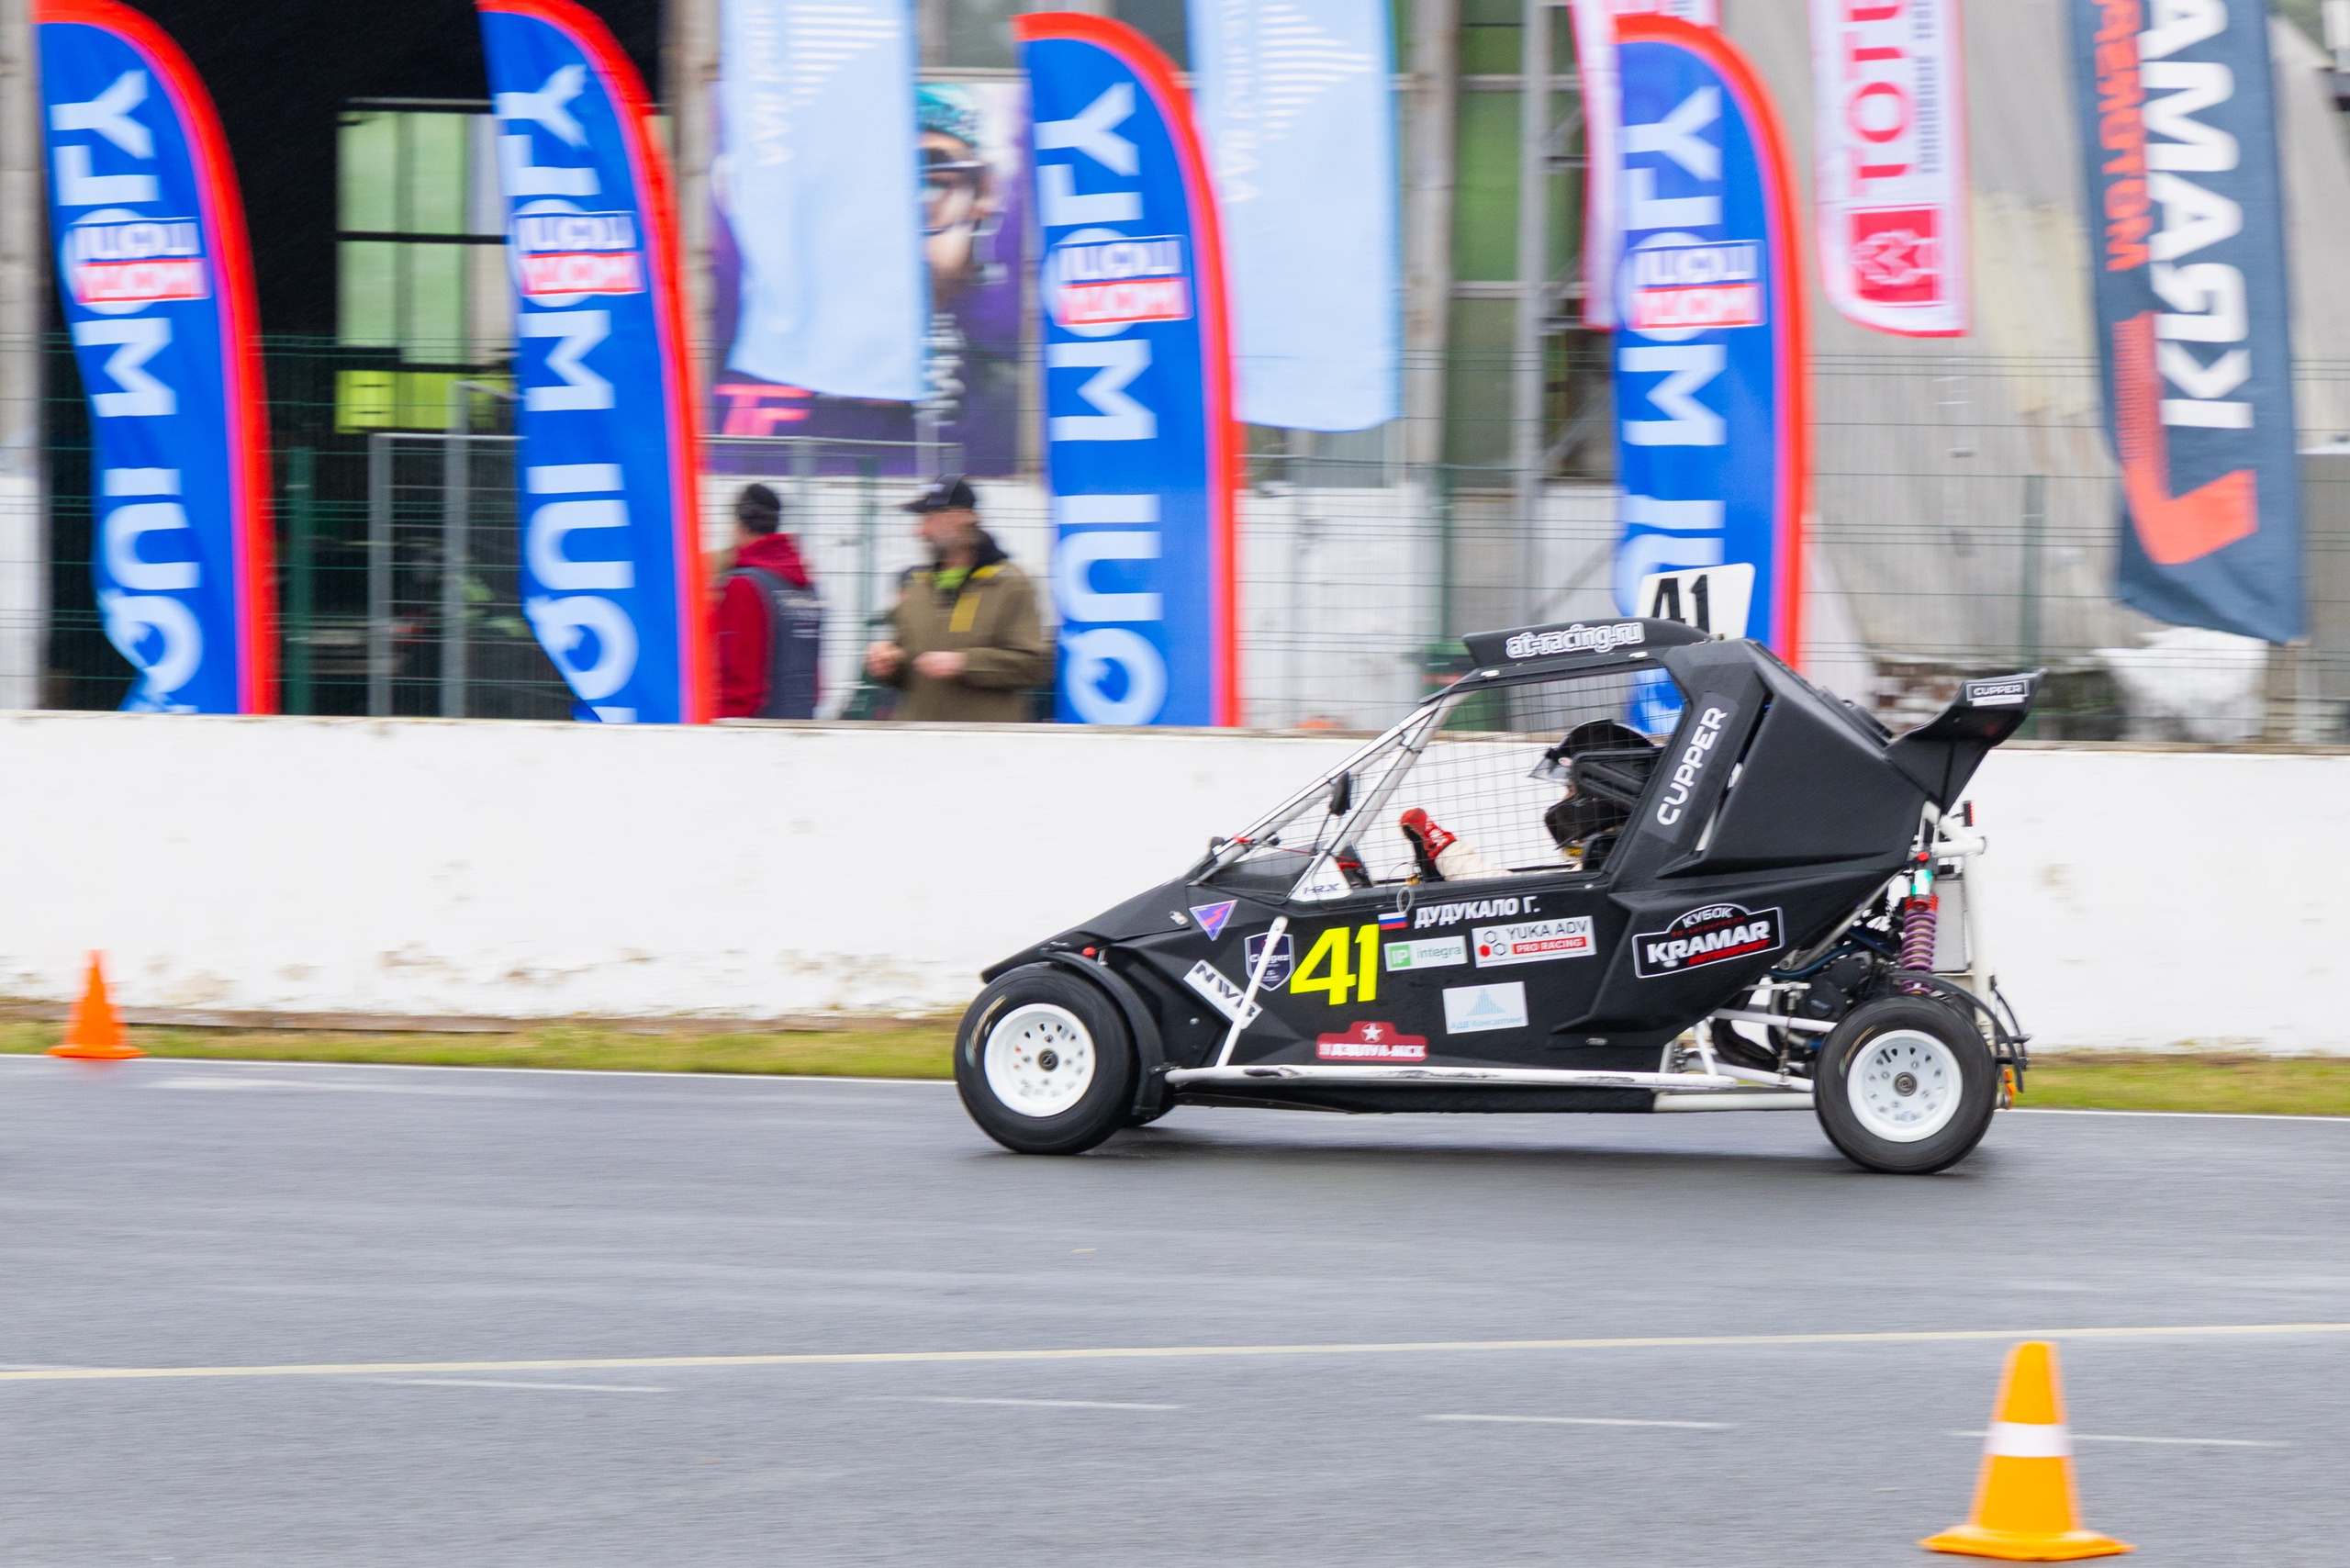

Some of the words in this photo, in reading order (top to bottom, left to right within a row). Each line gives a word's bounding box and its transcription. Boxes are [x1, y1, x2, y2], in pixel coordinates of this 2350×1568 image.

[1651, 574, 1710, 634] 41
[1506, 622, 1645, 658] at-racing.ru
[1973, 684, 2023, 696] CUPPER
[1656, 707, 1729, 825] CUPPER
[1414, 897, 1519, 929] ДУДУКАЛО
[1522, 895, 1541, 913] Г.
[1682, 906, 1735, 928] КУБОК
[1506, 924, 1551, 940] YUKA
[1554, 919, 1589, 935] ADV
[1516, 943, 1539, 953] PRO
[1540, 938, 1583, 951] RACING
[1646, 920, 1772, 964] KRAMAR
[1290, 924, 1380, 1005] 41
[1416, 945, 1462, 959] integra
